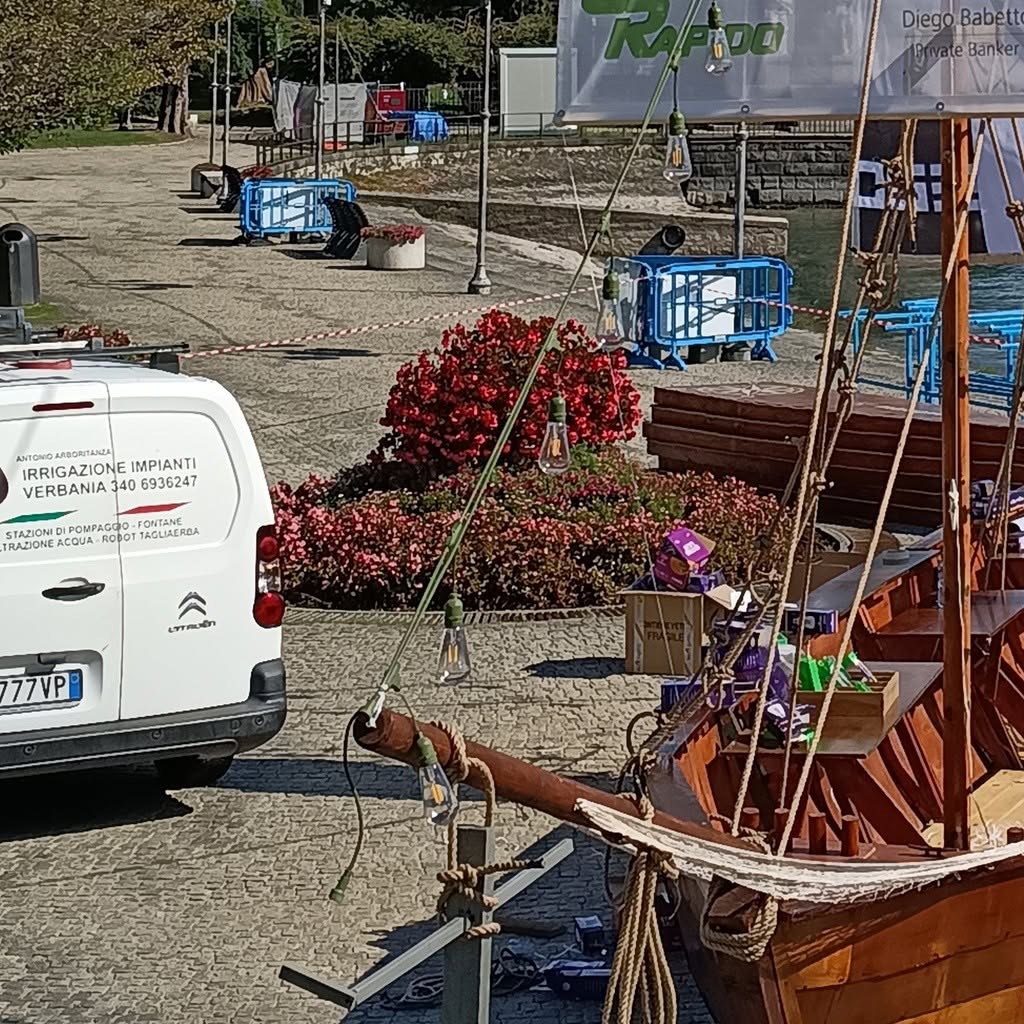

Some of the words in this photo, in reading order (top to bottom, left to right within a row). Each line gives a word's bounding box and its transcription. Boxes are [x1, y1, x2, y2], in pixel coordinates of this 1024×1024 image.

[902, 8, 954, 32] Diego
[968, 39, 1019, 57] Banker
[22, 462, 126, 481] IRRIGAZIONE
[131, 457, 197, 473] IMPIANTI
[22, 481, 107, 499] VERBANIA
[111, 478, 136, 493] 340
[140, 474, 198, 491] 6936247
[5, 528, 53, 540] STAZIONI
[137, 517, 183, 529] FONTANE
[57, 536, 93, 547] ACQUA
